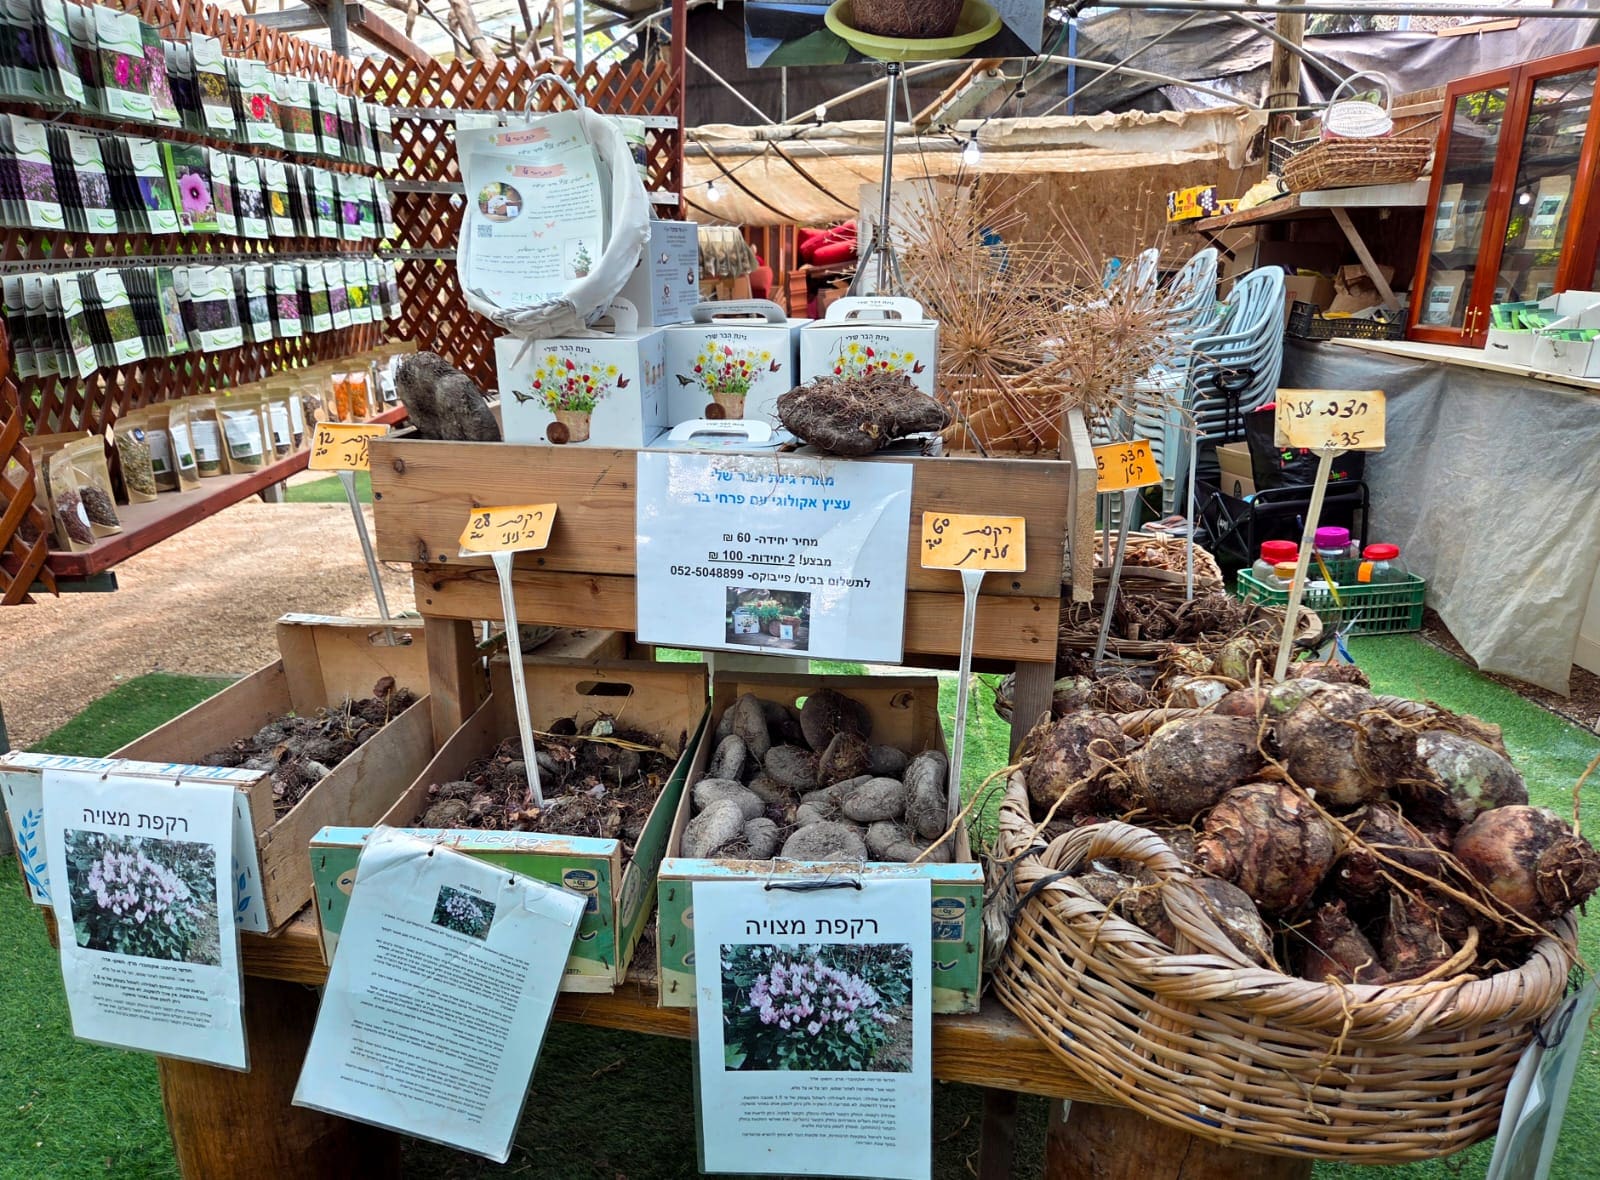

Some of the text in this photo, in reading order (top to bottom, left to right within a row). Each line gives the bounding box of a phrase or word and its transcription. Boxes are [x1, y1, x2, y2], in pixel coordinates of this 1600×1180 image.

[319, 432, 335, 446] 12
[1340, 430, 1365, 447] 35
[694, 492, 852, 512] עציץ אקולוגי עם פרחי בר
[932, 518, 950, 534] 60
[737, 532, 752, 544] 60
[754, 534, 788, 546] יחידה-
[792, 538, 818, 548] מחיר
[722, 550, 744, 562] 100
[746, 553, 786, 564] יחידות-
[788, 554, 796, 564] 2
[799, 556, 832, 568] מבצע!
[670, 566, 871, 588] לתשלום בביט/ פייבוקס- 052-5048899
[83, 807, 188, 835] רקפת מצויה
[746, 917, 878, 939] רקפת מצויה
